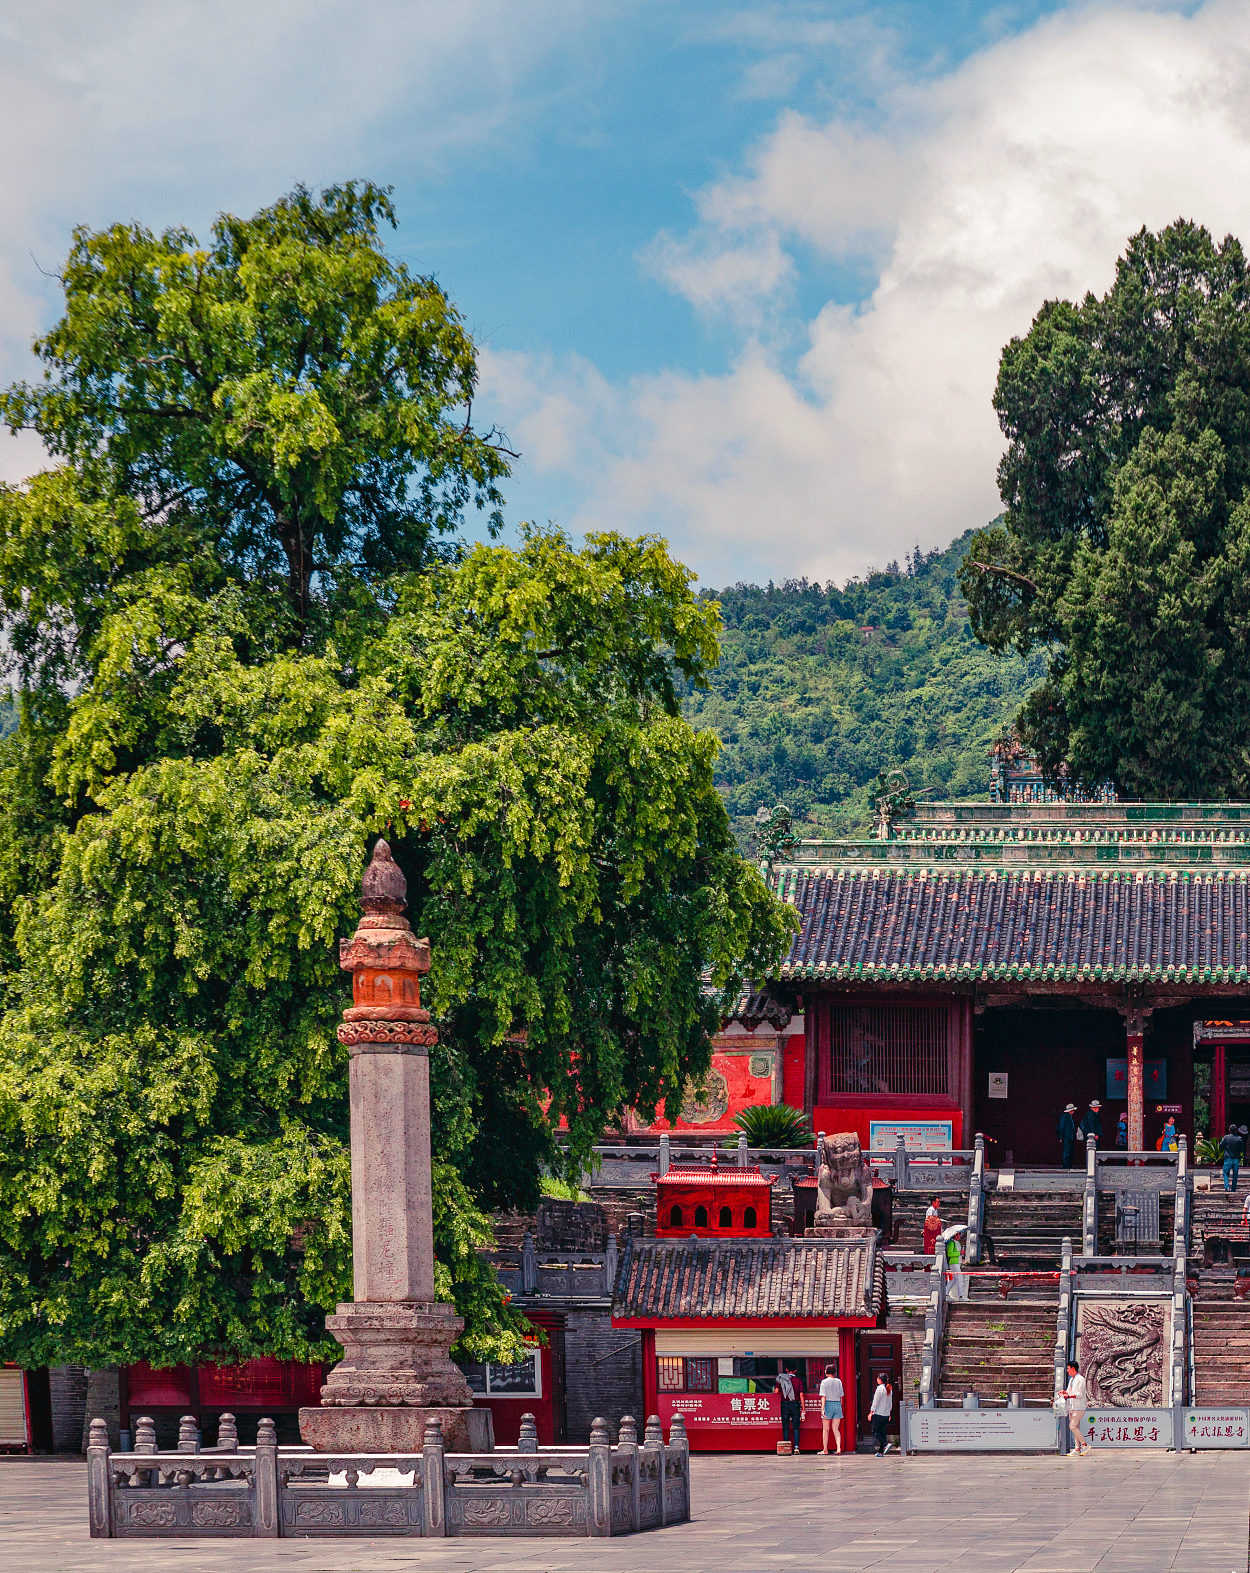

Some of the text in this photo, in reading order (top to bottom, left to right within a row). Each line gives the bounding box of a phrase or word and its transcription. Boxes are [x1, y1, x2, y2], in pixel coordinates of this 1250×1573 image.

[730, 1397, 770, 1411] 售票处
[1084, 1426, 1160, 1442] 平武报恩寺
[1188, 1425, 1245, 1437] 平武报恩寺
